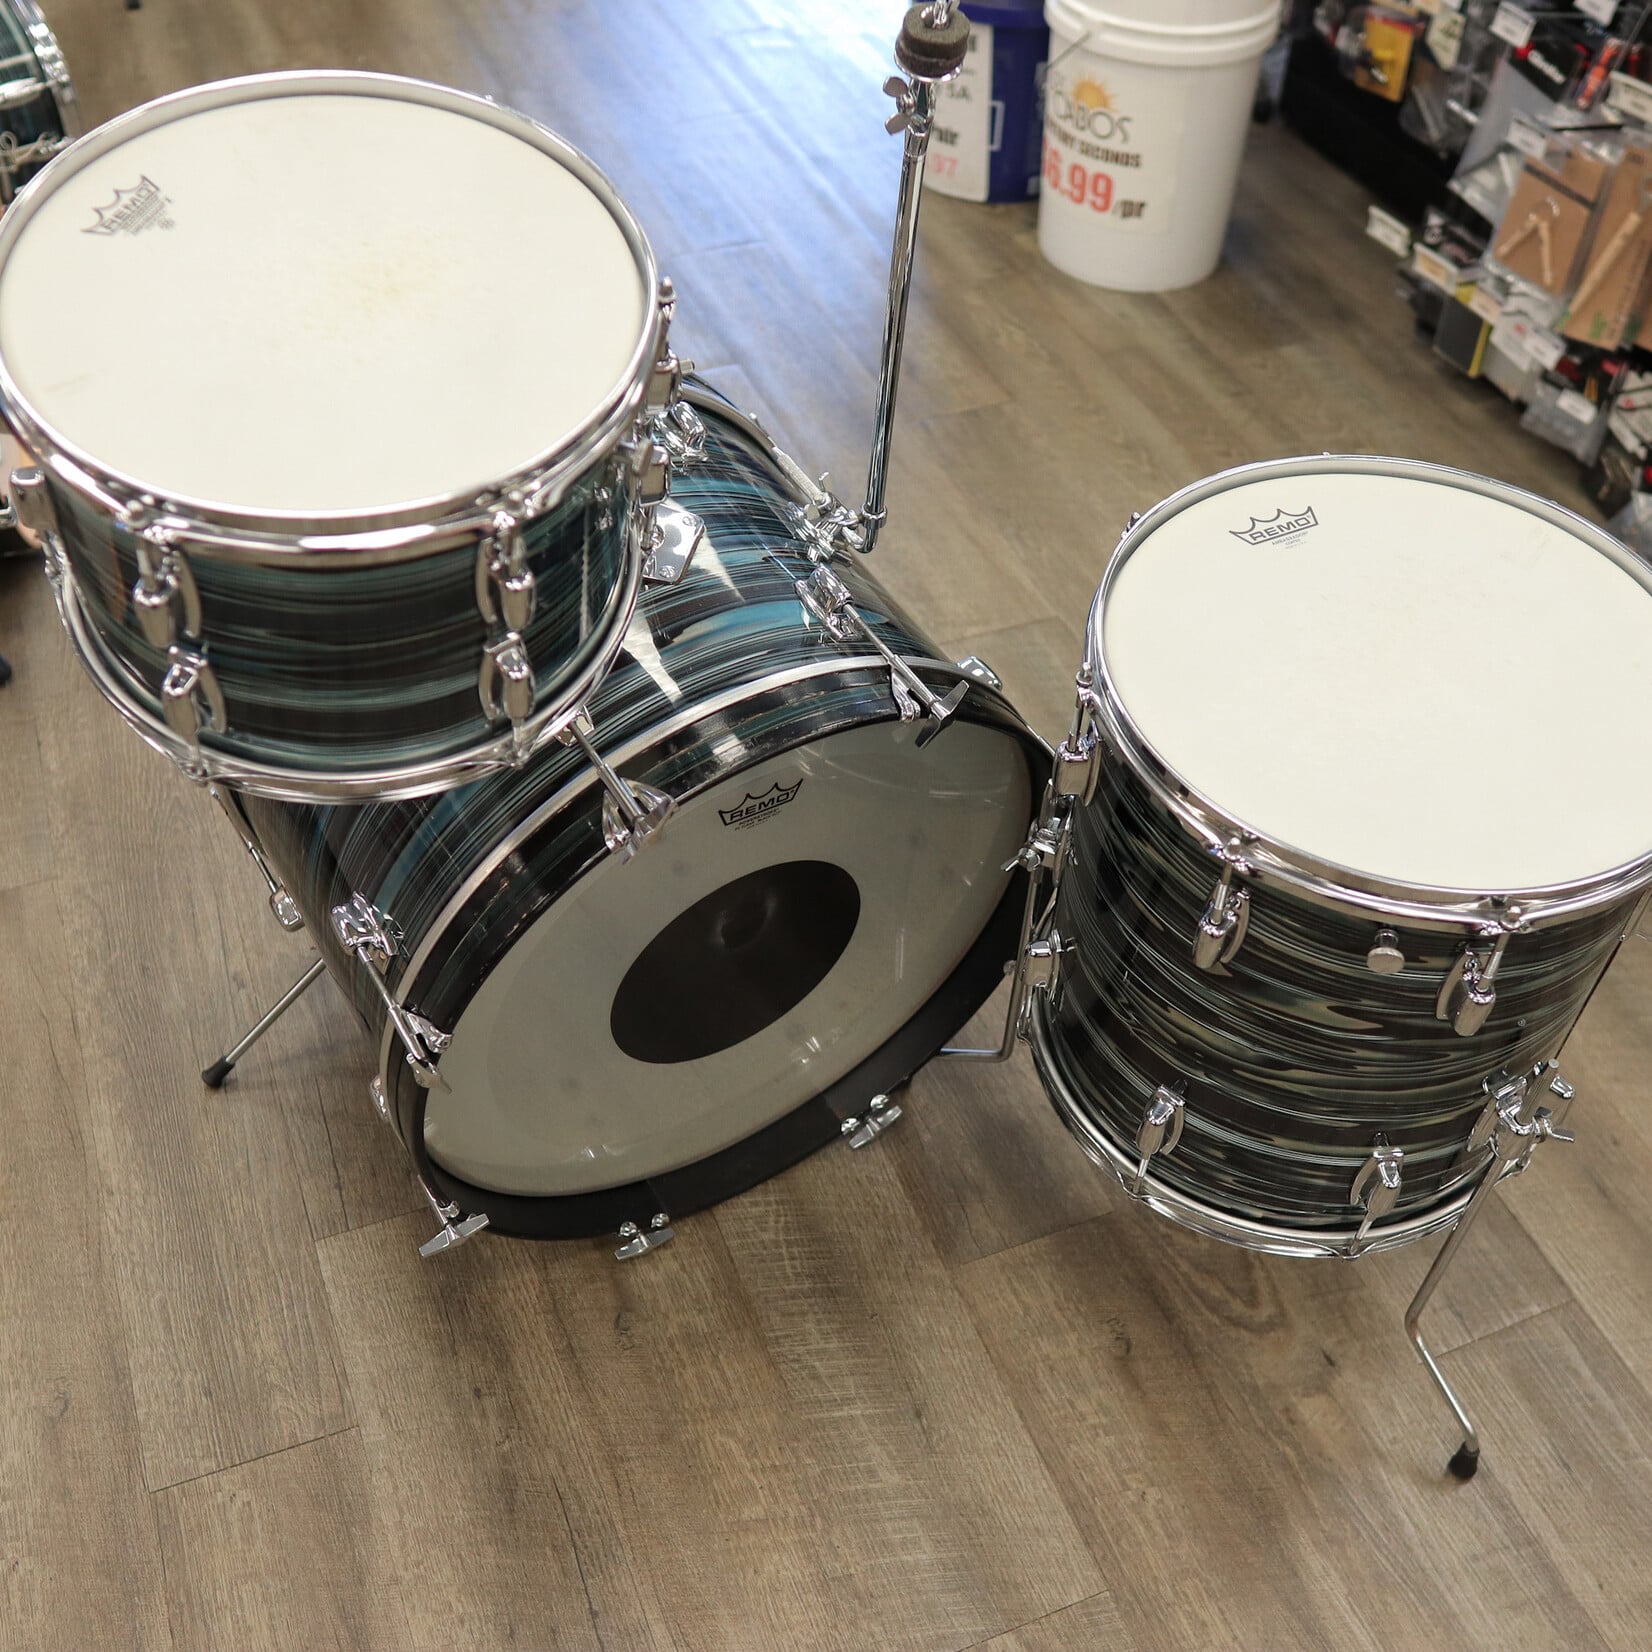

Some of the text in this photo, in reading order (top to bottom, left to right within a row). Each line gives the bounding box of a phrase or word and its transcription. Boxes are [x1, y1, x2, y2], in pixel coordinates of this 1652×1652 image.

[1079, 140, 1142, 169] SECONDS
[1249, 516, 1311, 541] REMO
[729, 791, 790, 821] REMO
